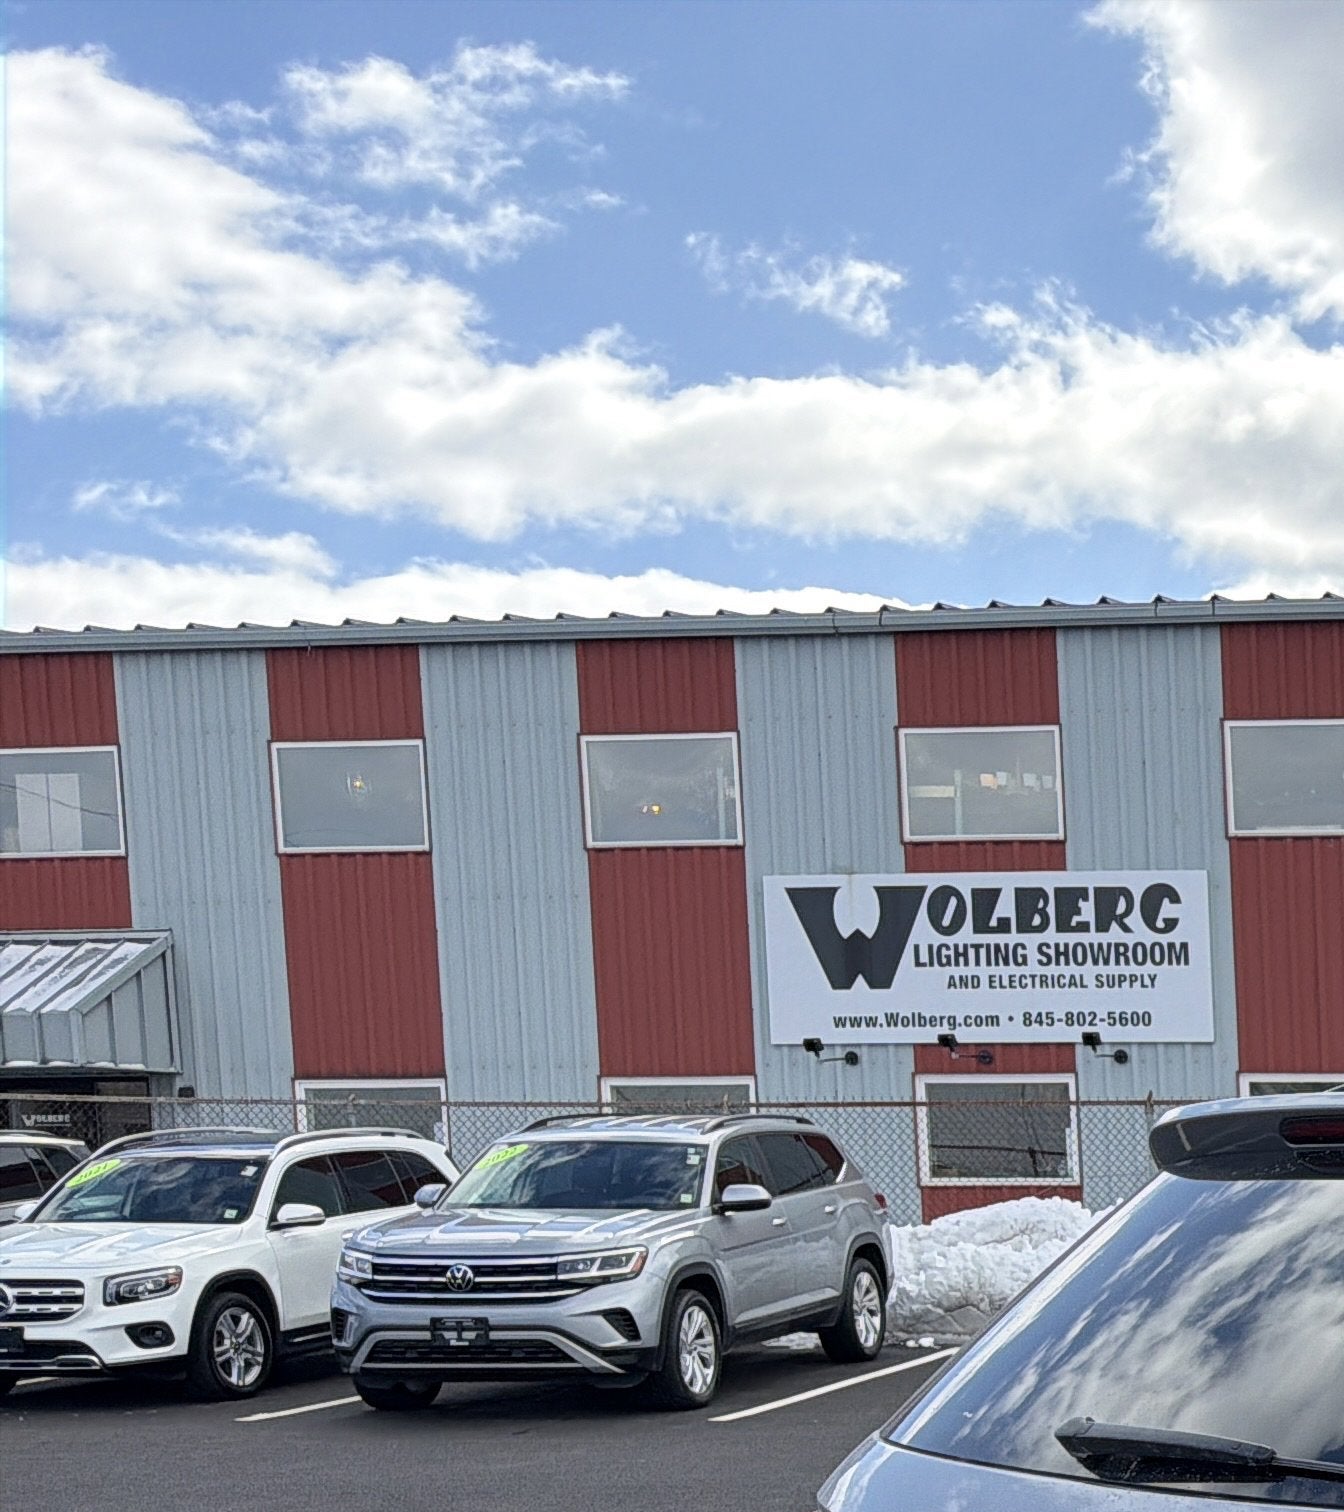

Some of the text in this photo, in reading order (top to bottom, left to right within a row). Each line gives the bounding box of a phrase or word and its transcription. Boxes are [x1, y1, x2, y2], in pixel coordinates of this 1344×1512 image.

[785, 883, 1182, 990] WOLBERG
[913, 942, 1190, 968] LIGHTING SHOWROOM
[947, 973, 1158, 989] AND ELECTRICAL SUPPLY
[833, 1011, 1152, 1031] www.Wolberg.com 845-802-5600
